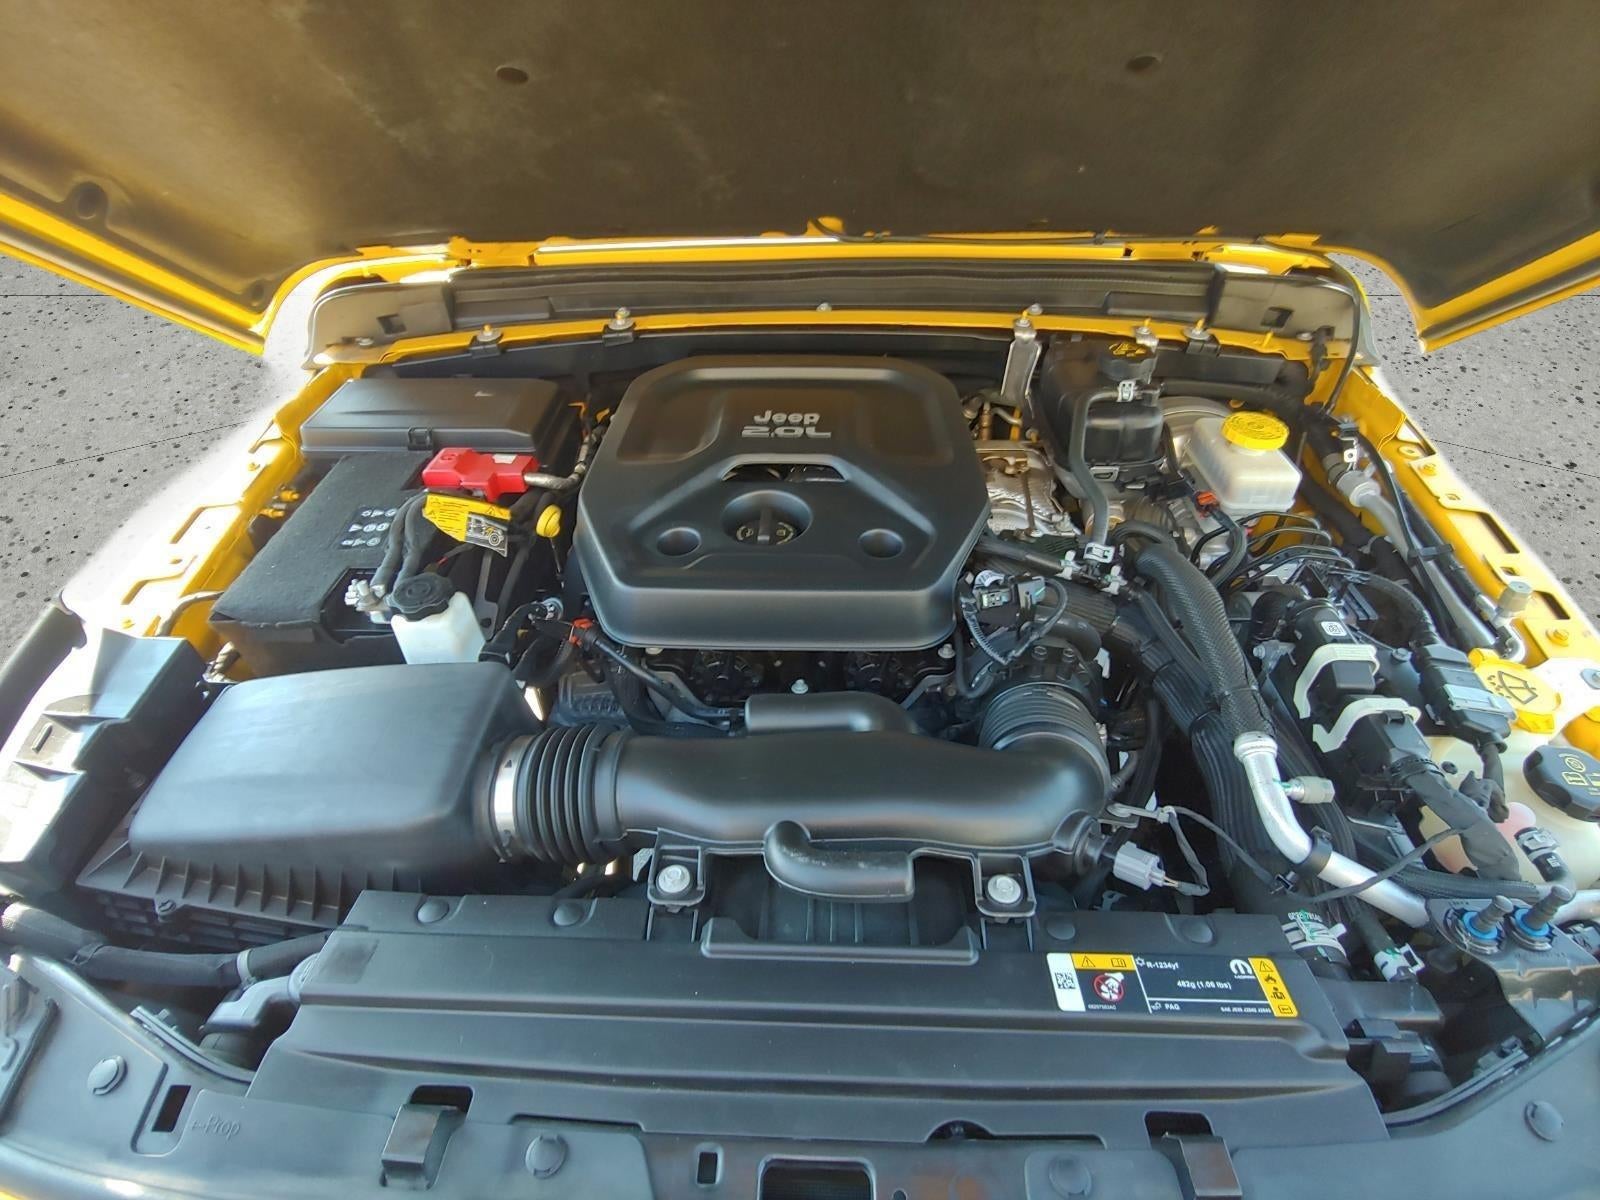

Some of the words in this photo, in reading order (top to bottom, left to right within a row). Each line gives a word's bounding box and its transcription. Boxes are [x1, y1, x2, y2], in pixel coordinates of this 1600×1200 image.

[753, 410, 820, 425] Jeep
[741, 425, 832, 438] 2.0L
[1216, 981, 1232, 990] lbs)
[1164, 1002, 1181, 1011] PAG
[205, 1113, 241, 1141] Prop
